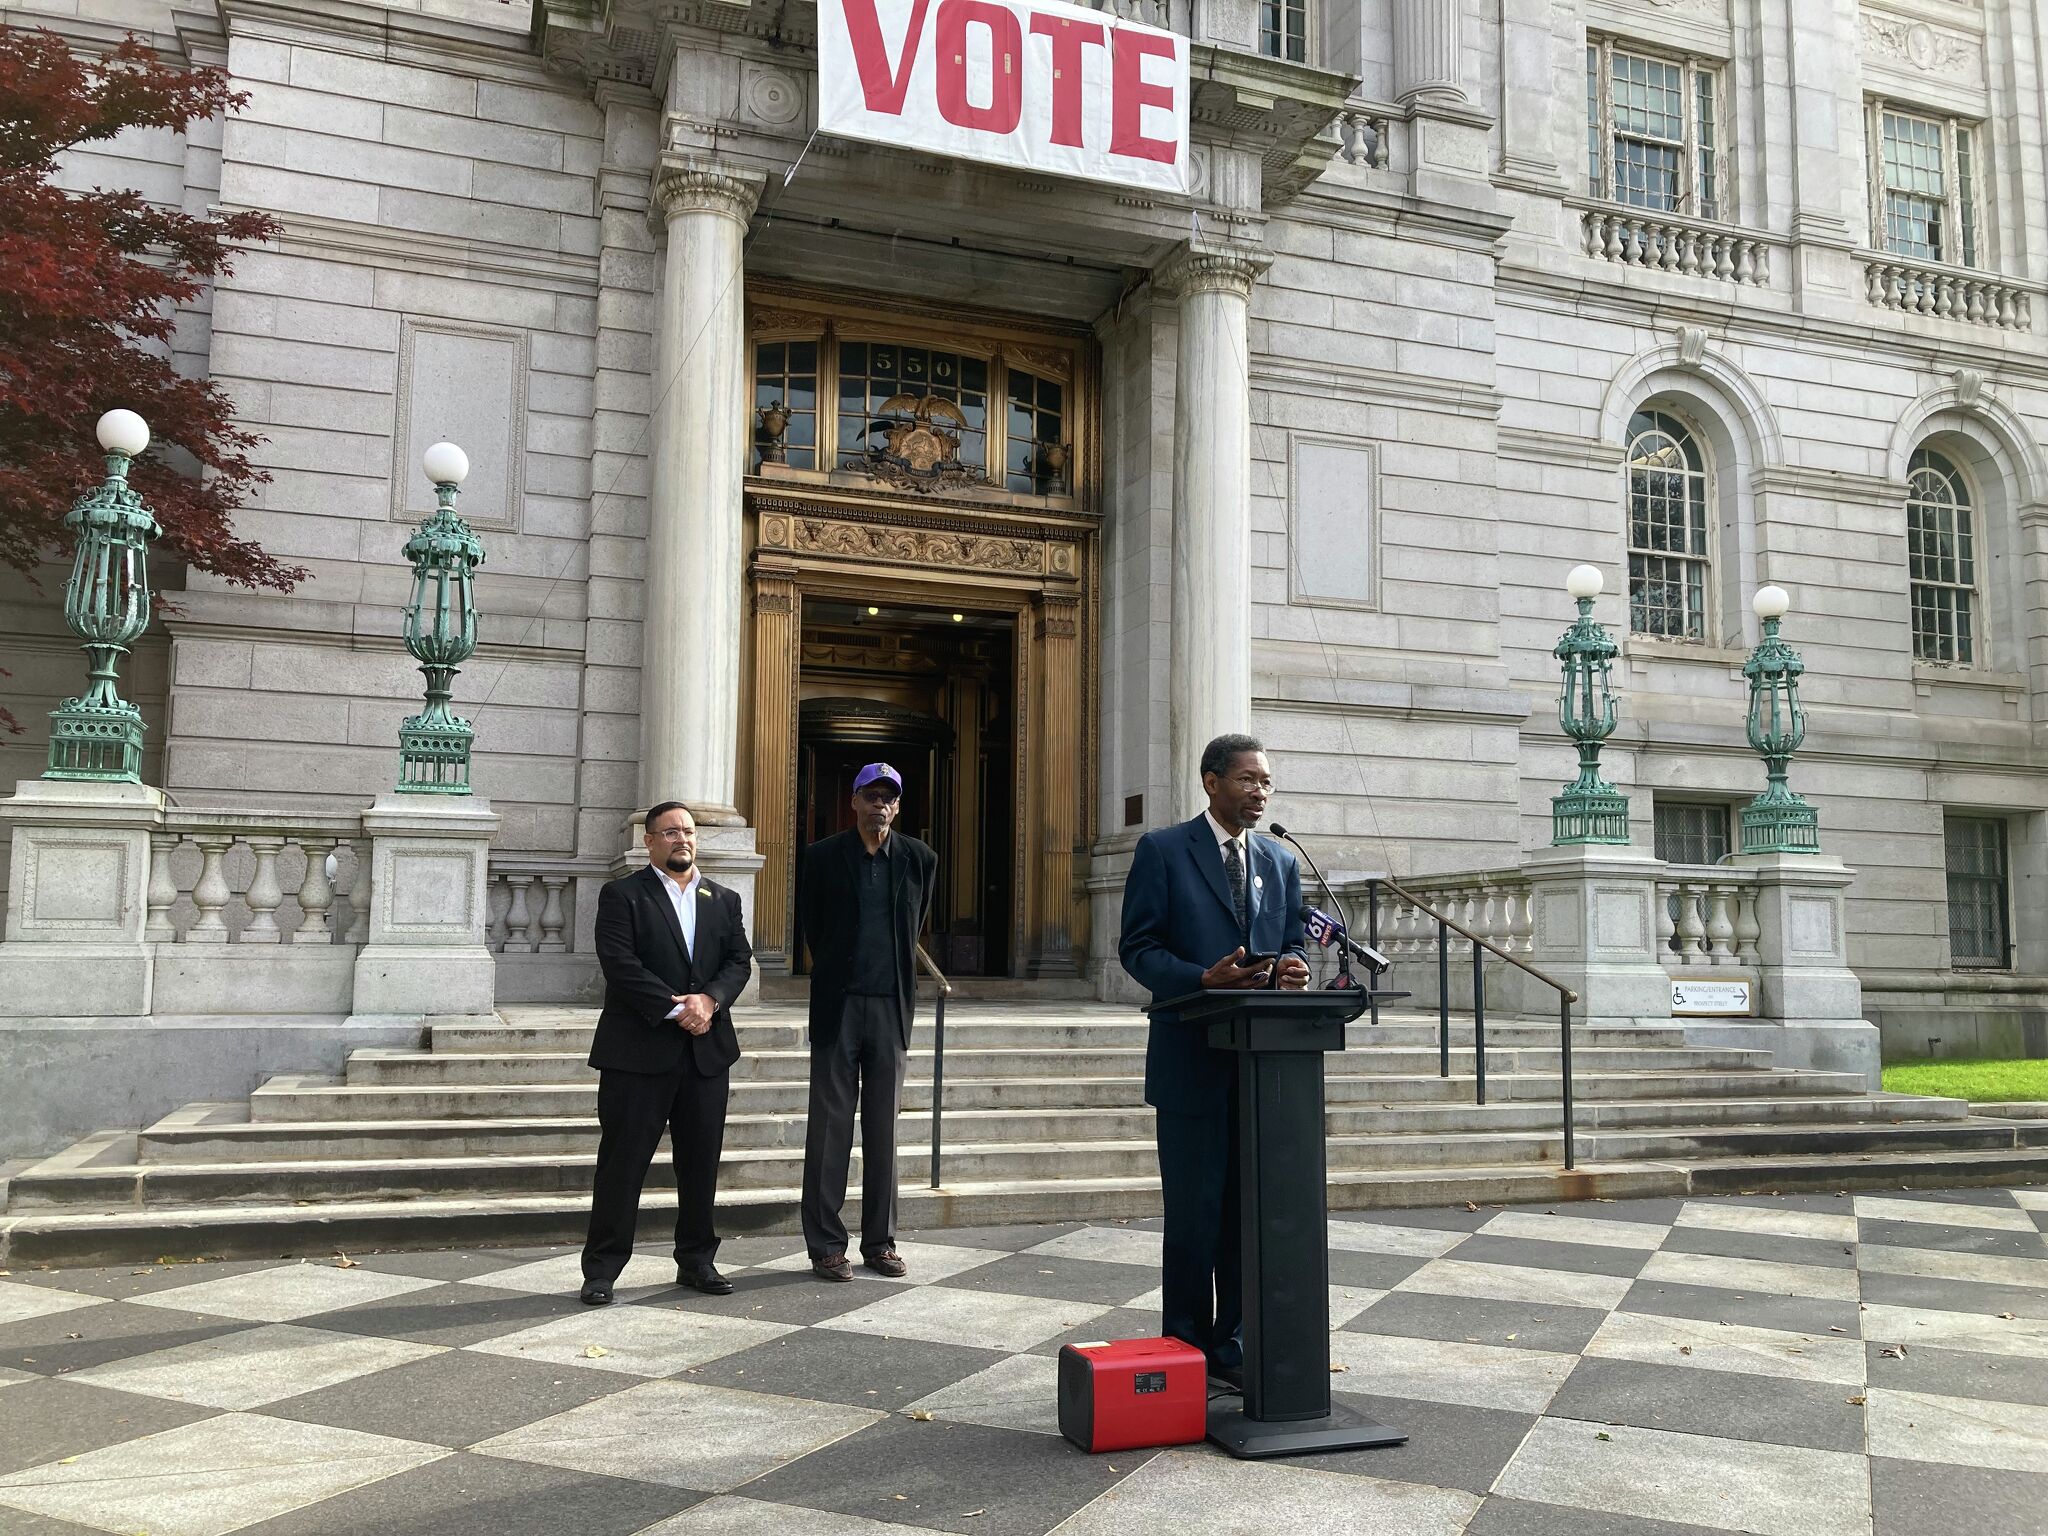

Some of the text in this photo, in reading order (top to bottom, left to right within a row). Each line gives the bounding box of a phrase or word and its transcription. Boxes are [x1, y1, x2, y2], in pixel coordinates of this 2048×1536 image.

[842, 0, 1178, 165] VOTE
[877, 353, 951, 377] 550
[1308, 915, 1325, 938] 61
[1321, 924, 1332, 945] NEWS
